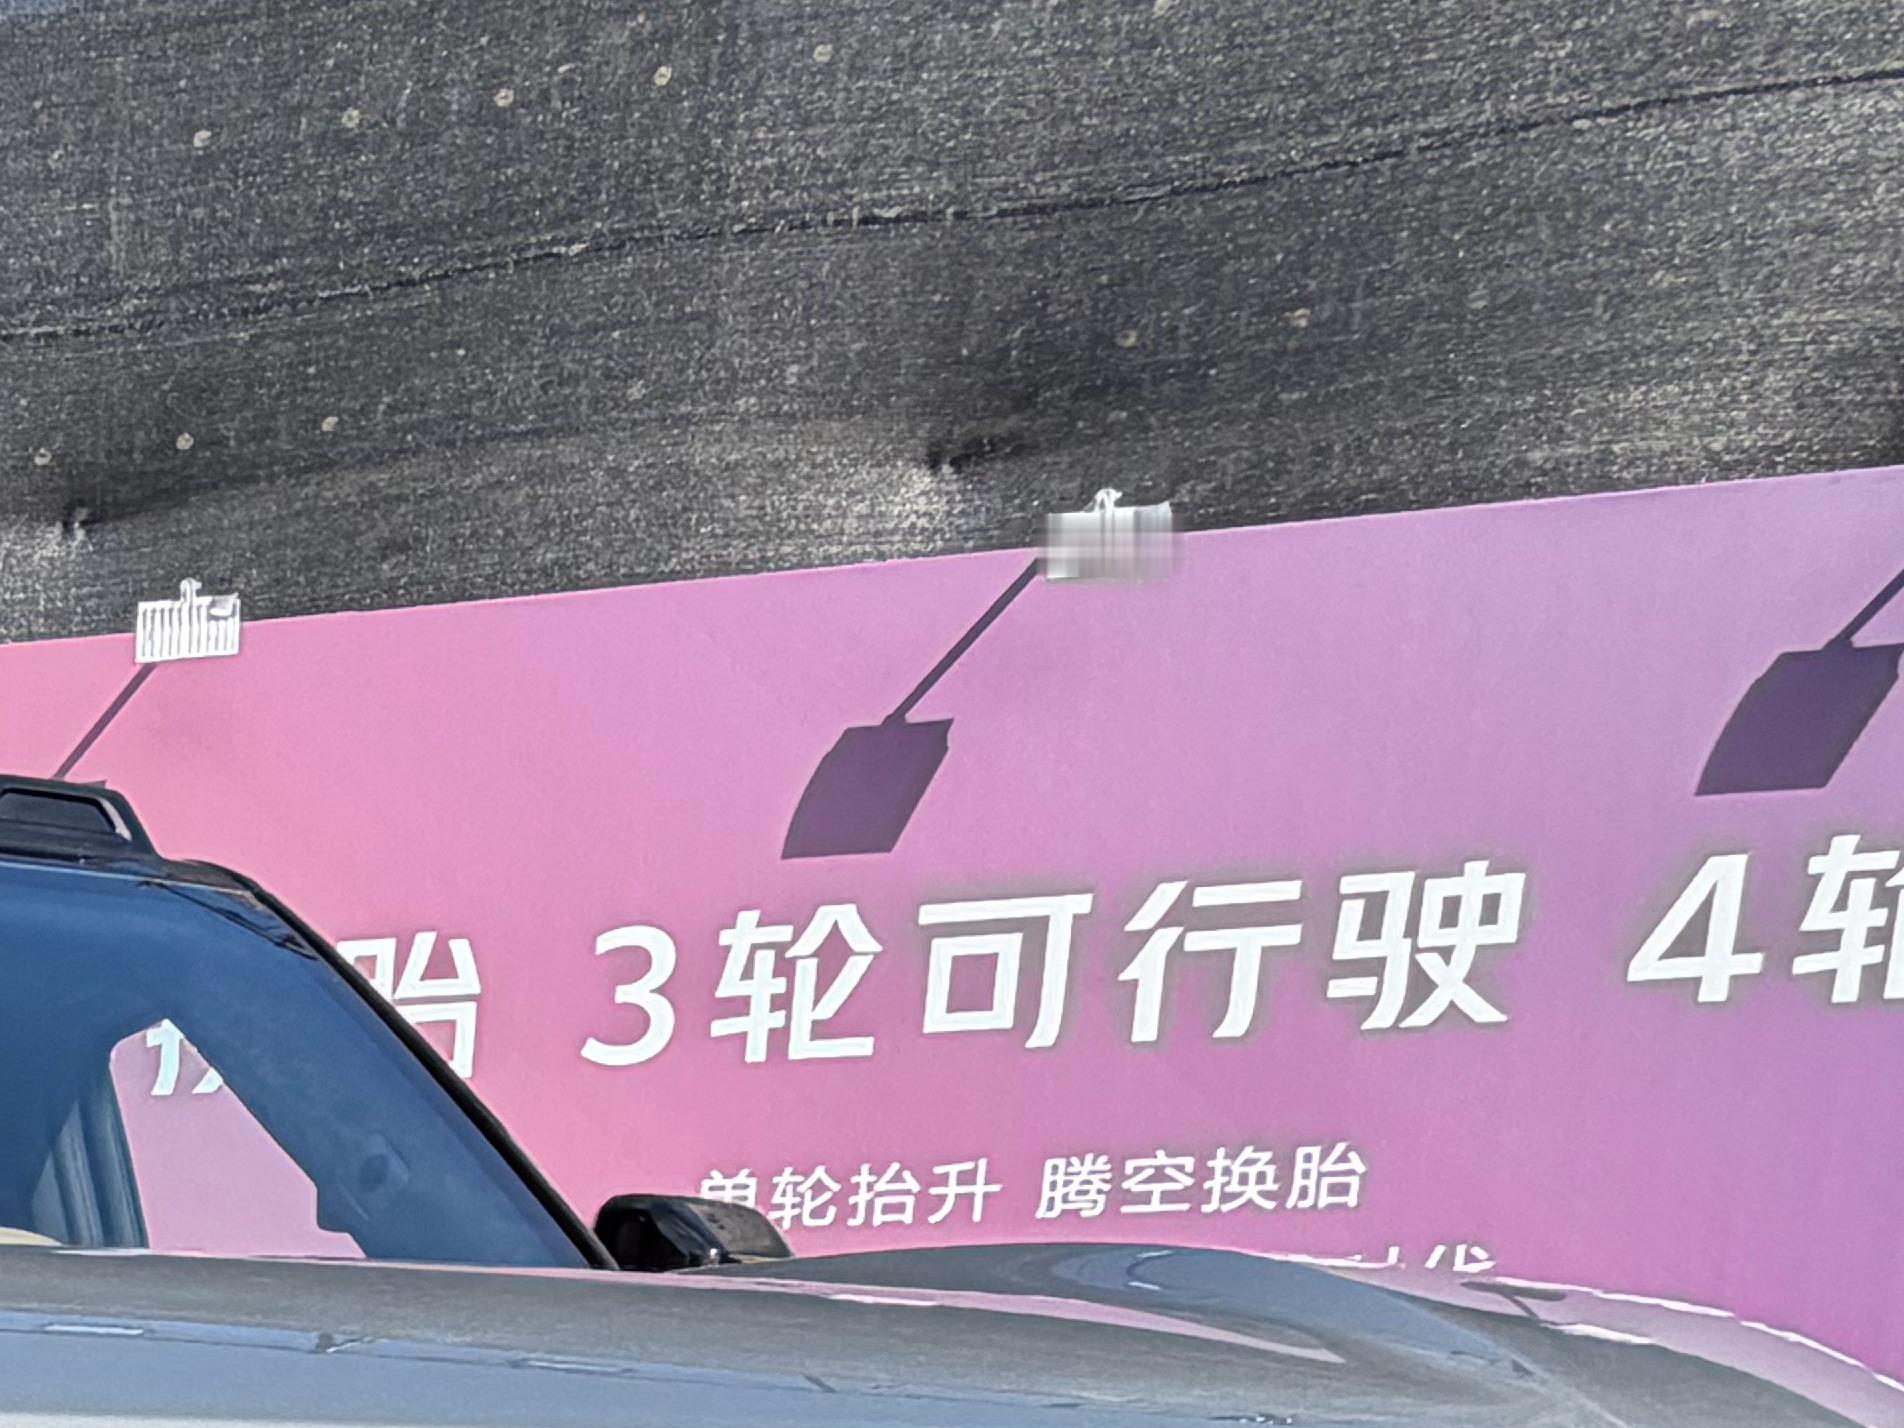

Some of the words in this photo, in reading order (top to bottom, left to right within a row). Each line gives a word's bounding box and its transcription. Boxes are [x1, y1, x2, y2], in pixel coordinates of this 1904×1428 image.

[580, 861, 1527, 1067] 3轮可行驶
[700, 1156, 1004, 1230] 单轮抬升
[1035, 1141, 1368, 1221] 腾空换胎
